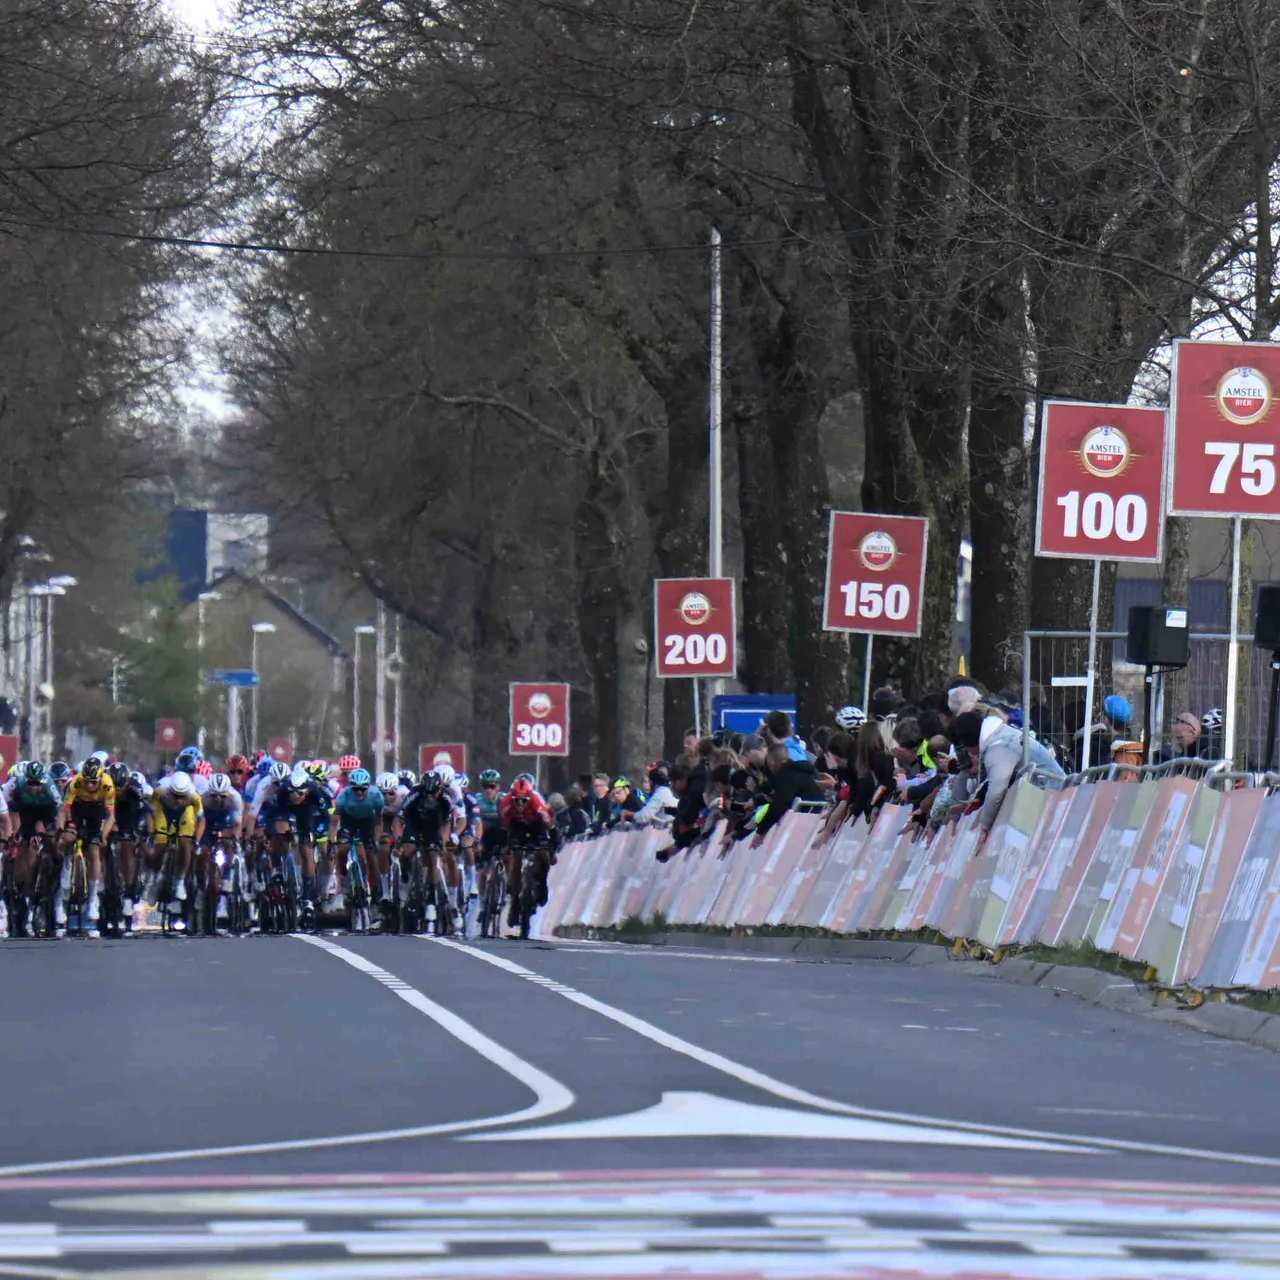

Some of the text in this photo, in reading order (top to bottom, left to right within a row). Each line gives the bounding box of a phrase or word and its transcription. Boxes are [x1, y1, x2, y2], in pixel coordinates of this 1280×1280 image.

[1225, 387, 1263, 398] AMSTEL
[1089, 443, 1123, 454] AMSTEL
[1204, 441, 1276, 496] 75
[1056, 489, 1148, 542] 100
[840, 580, 910, 621] 150
[664, 633, 727, 666] 200
[516, 722, 563, 747] 300
